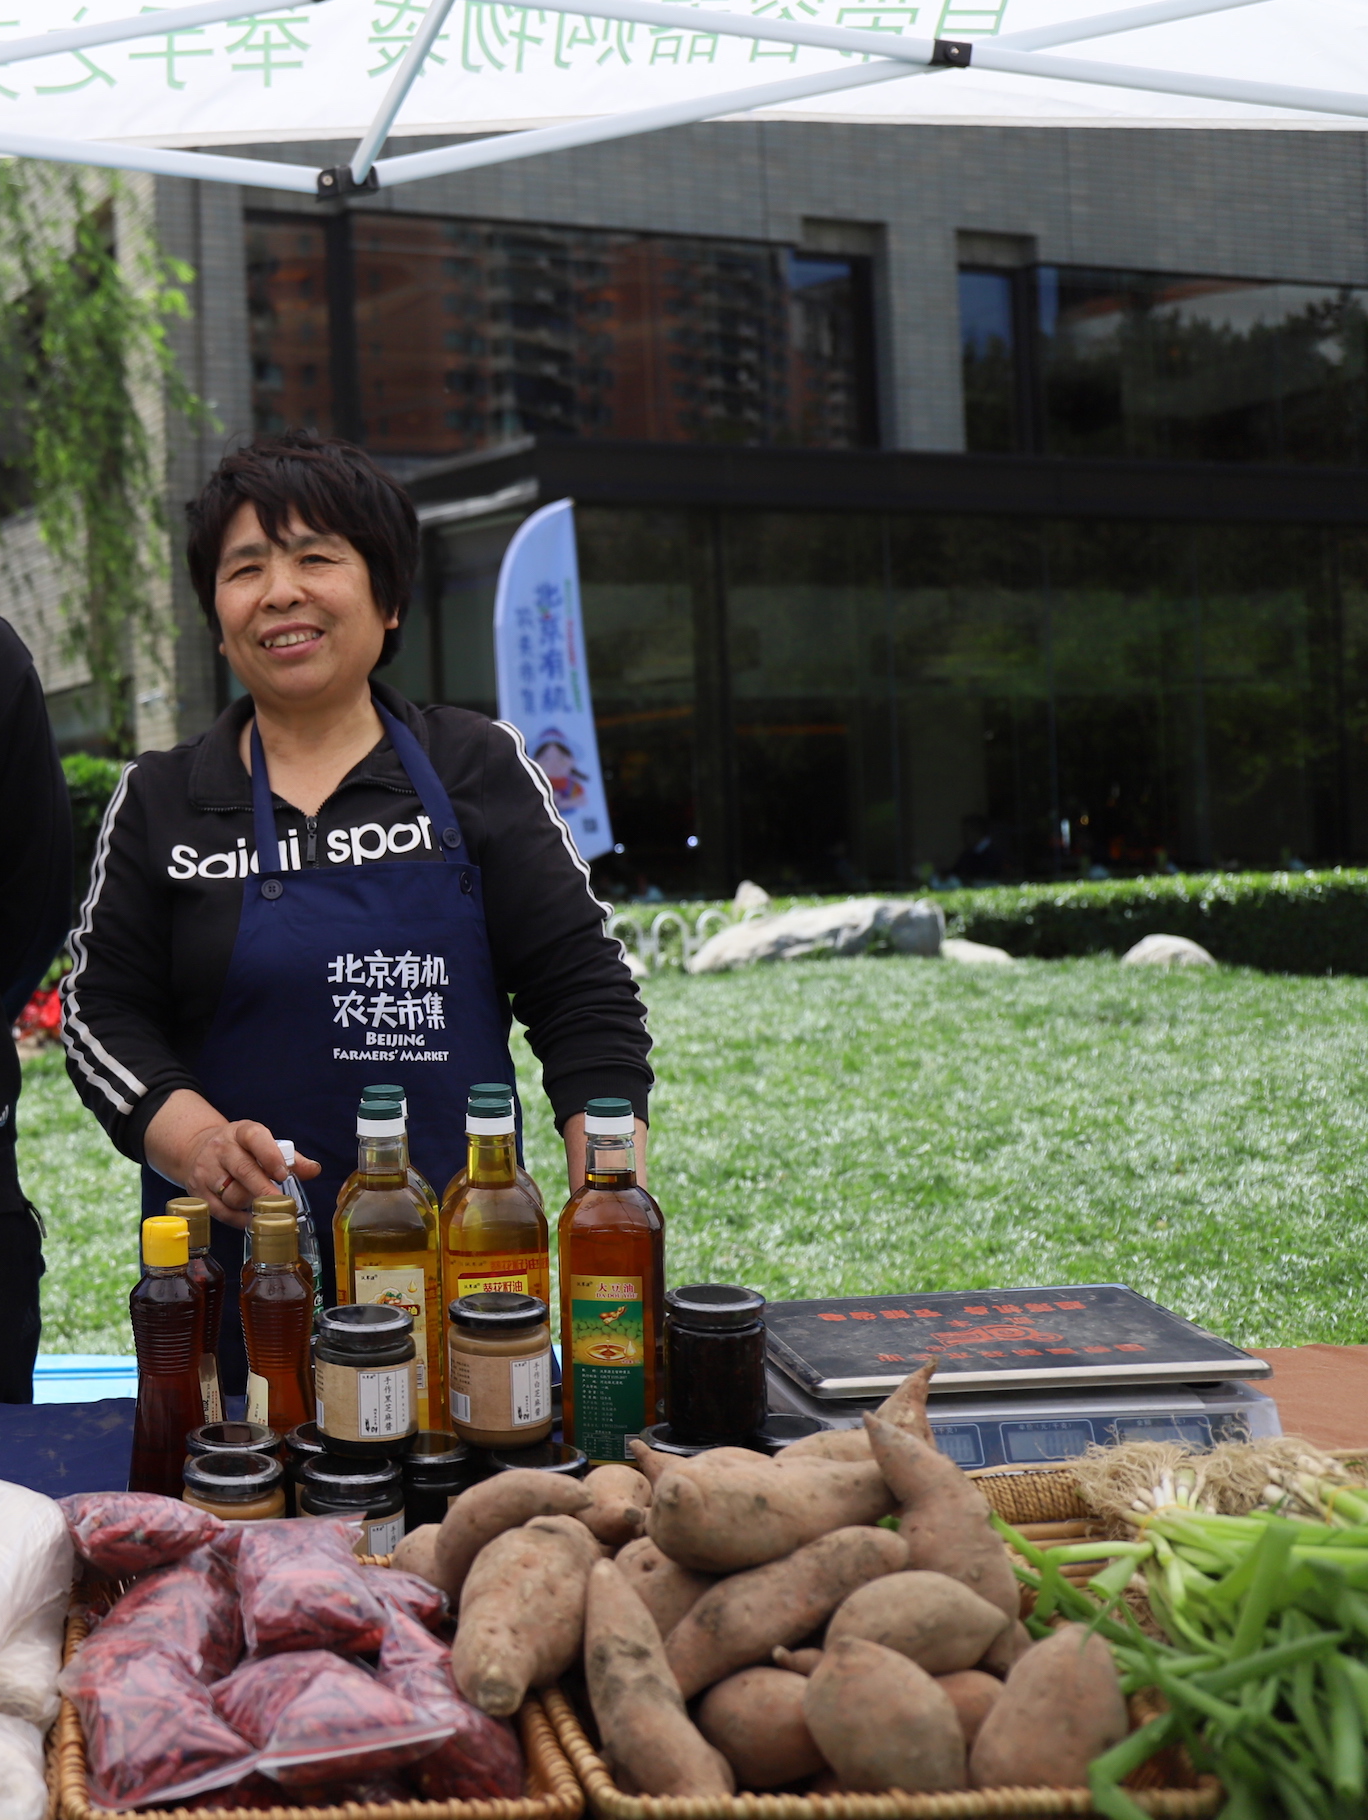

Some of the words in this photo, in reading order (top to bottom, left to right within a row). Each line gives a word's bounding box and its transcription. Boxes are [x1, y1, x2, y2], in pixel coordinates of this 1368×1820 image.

[327, 815, 443, 866] spor
[327, 949, 449, 990] 北京有机
[331, 989, 446, 1030] 农夫市集
[365, 1031, 425, 1047] BEIJING
[400, 1050, 449, 1061] MARKET
[482, 1280, 523, 1293] 葵花籽油
[596, 1282, 635, 1293] 大豆油
